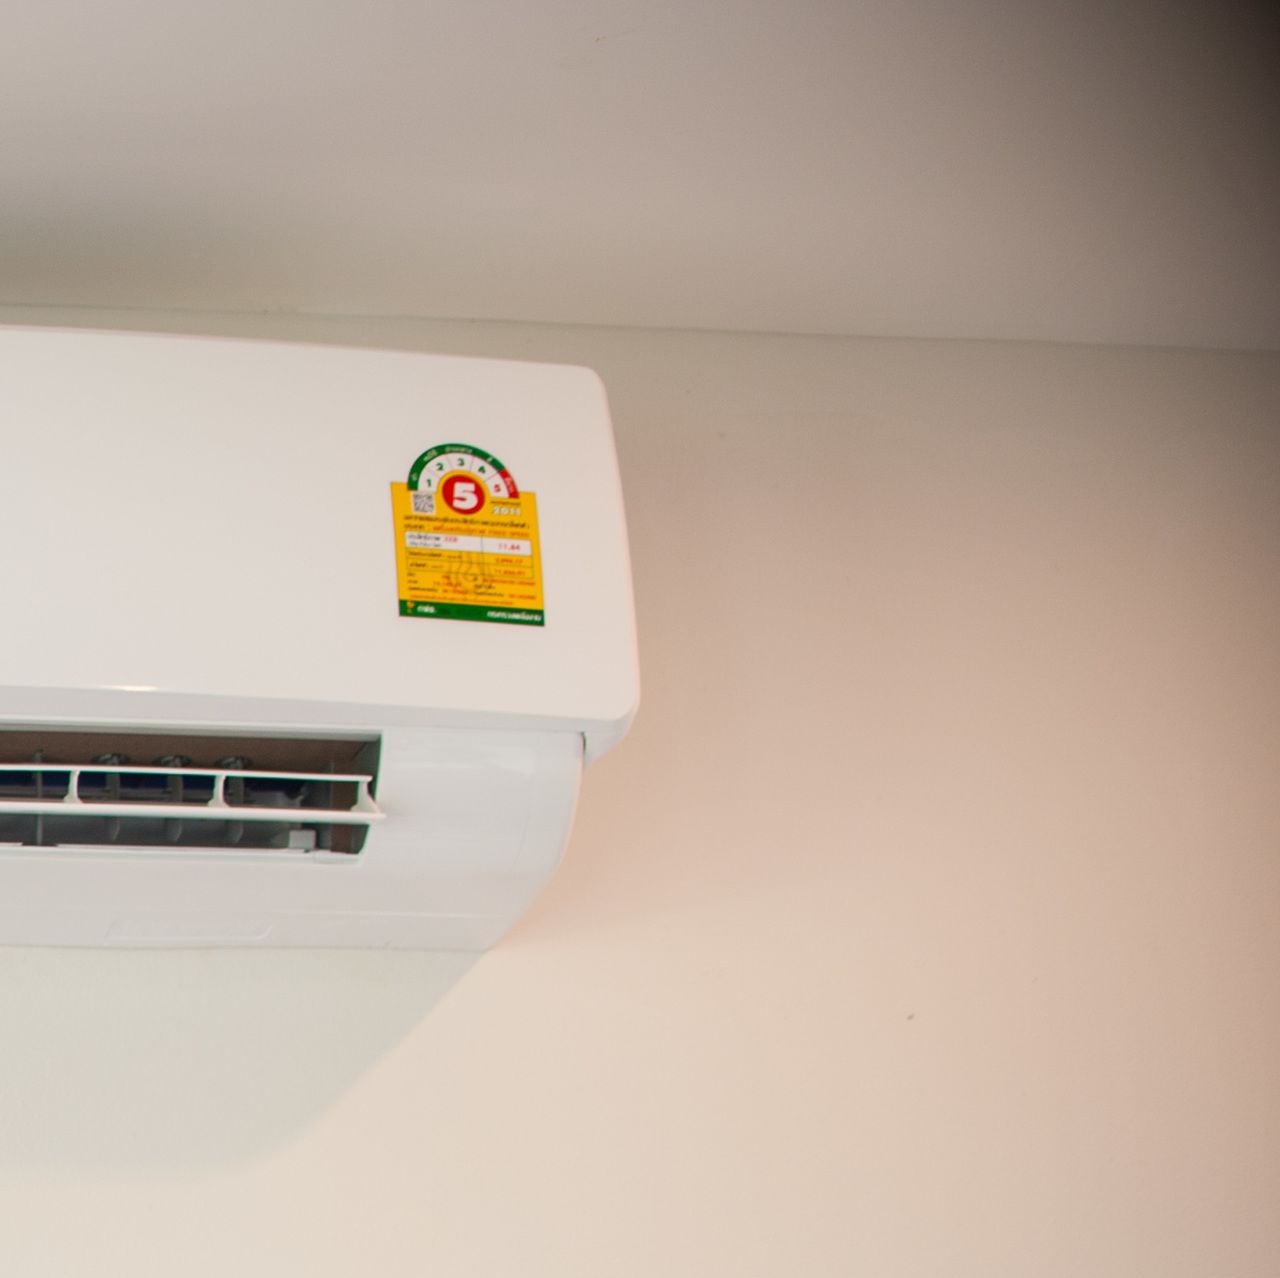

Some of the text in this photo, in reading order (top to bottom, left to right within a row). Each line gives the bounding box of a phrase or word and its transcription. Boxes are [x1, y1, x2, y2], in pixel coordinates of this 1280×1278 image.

[436, 462, 444, 471] 2
[457, 458, 465, 466] 3
[478, 465, 486, 474] 4
[493, 484, 501, 493] 5
[452, 481, 479, 510] 5
